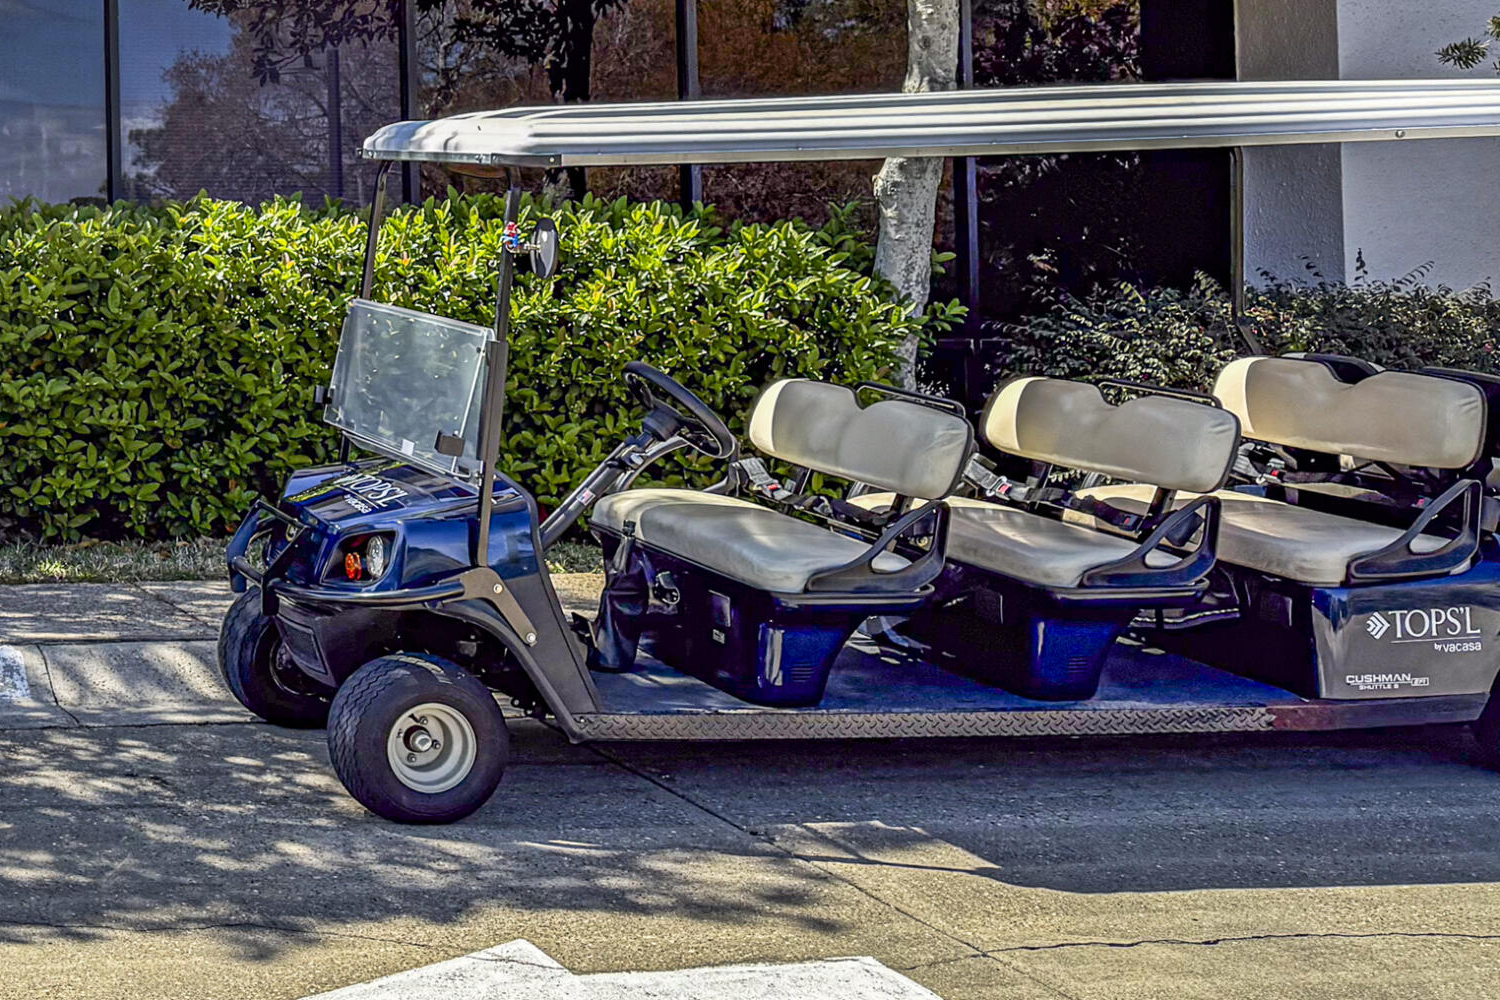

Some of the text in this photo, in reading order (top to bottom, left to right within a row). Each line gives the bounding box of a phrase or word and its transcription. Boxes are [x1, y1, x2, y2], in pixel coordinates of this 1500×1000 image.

[1388, 606, 1481, 638] TOPS'L
[1434, 641, 1482, 653] by vacasa
[1345, 673, 1411, 684] CUSHMAN
